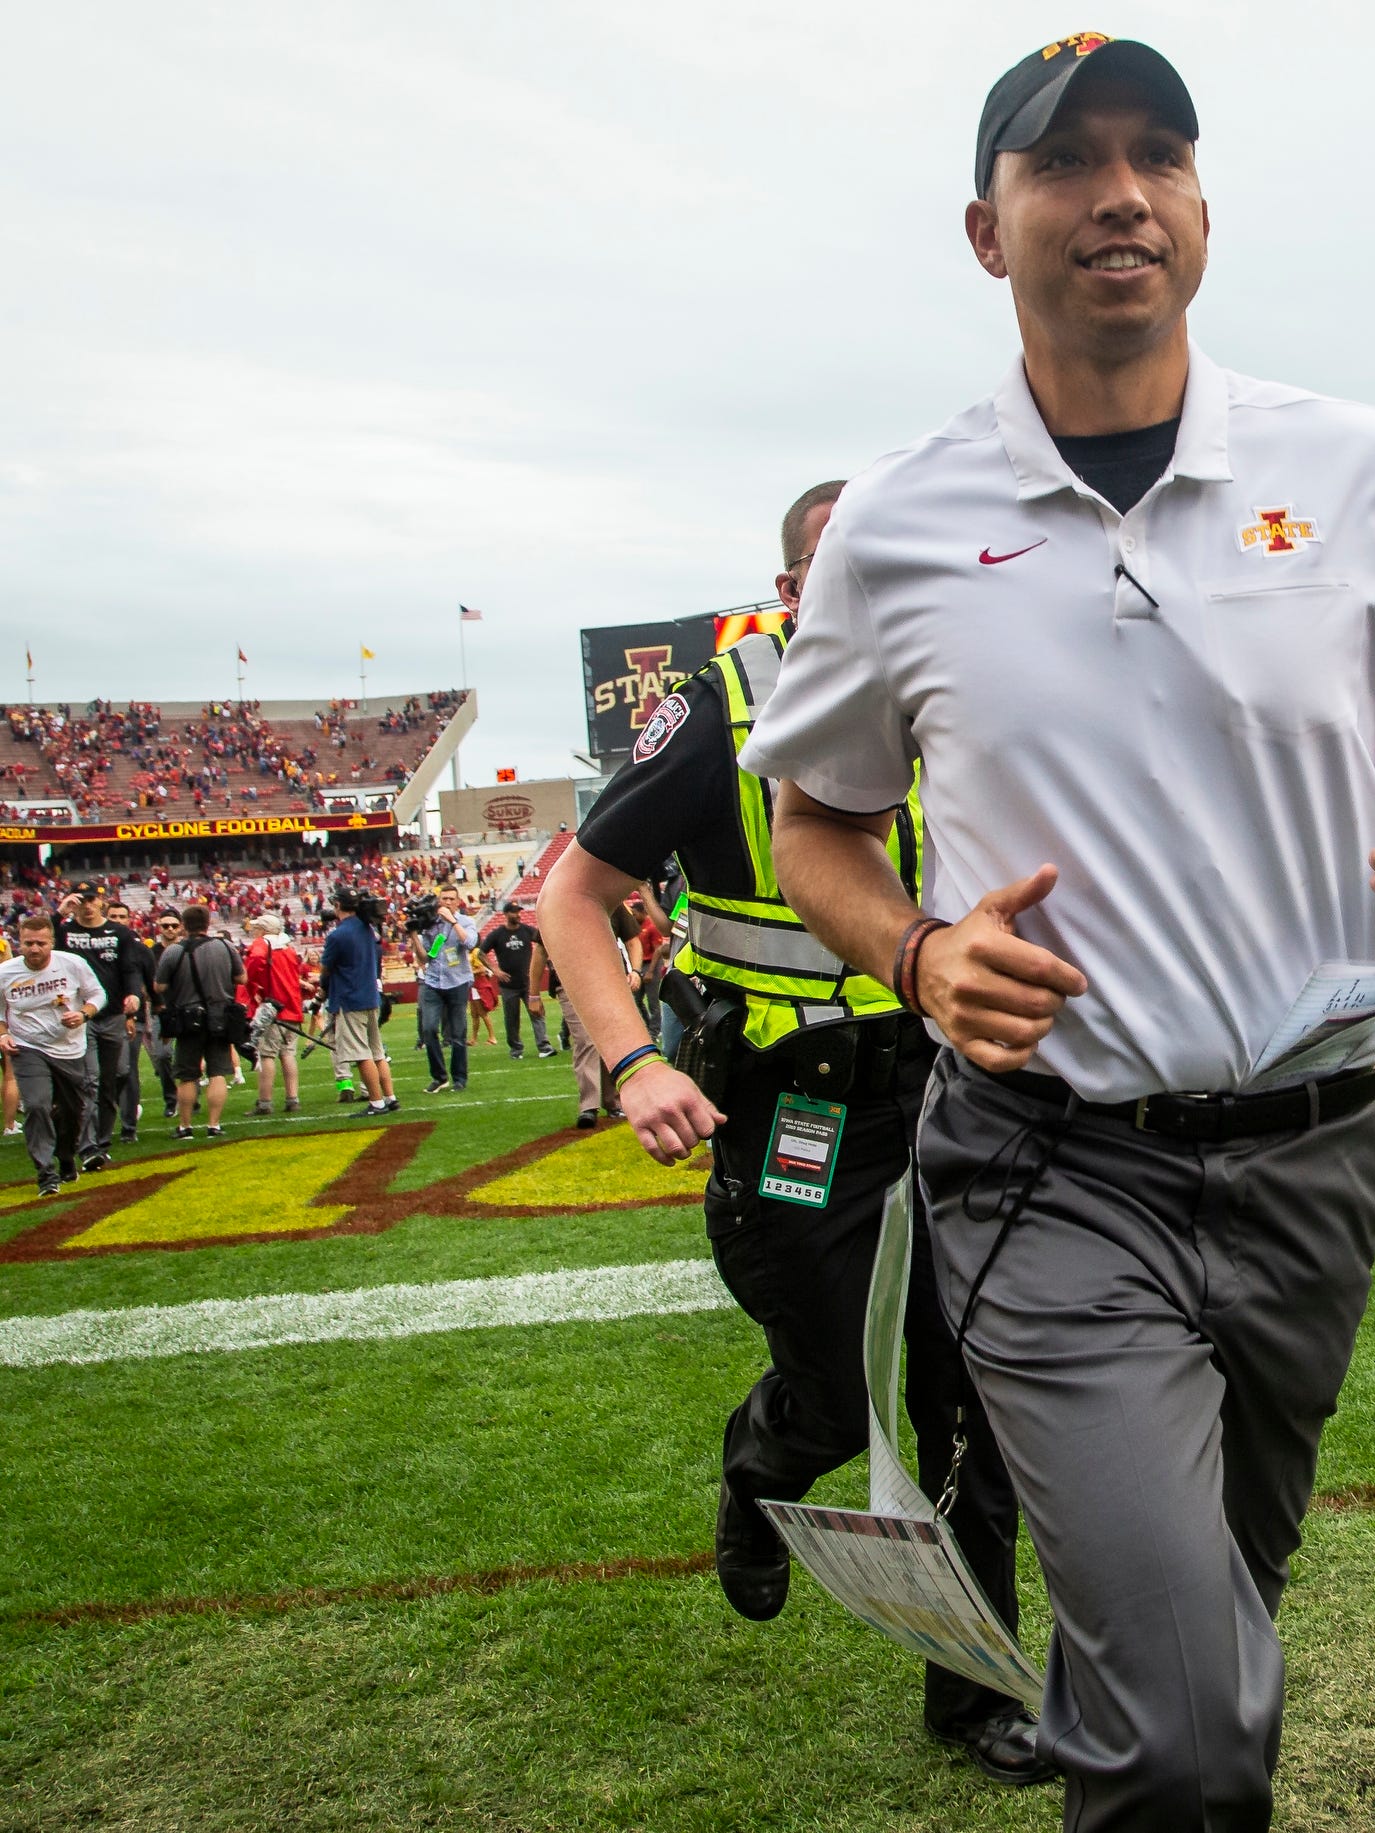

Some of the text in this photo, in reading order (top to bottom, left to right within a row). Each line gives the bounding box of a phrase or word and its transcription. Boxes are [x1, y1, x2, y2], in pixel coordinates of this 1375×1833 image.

[1241, 521, 1314, 547] STATE
[594, 670, 694, 714] STAT
[116, 820, 211, 839] CYCLONE
[215, 816, 316, 834] FOOTBALL
[10, 978, 68, 999] CYCLONES
